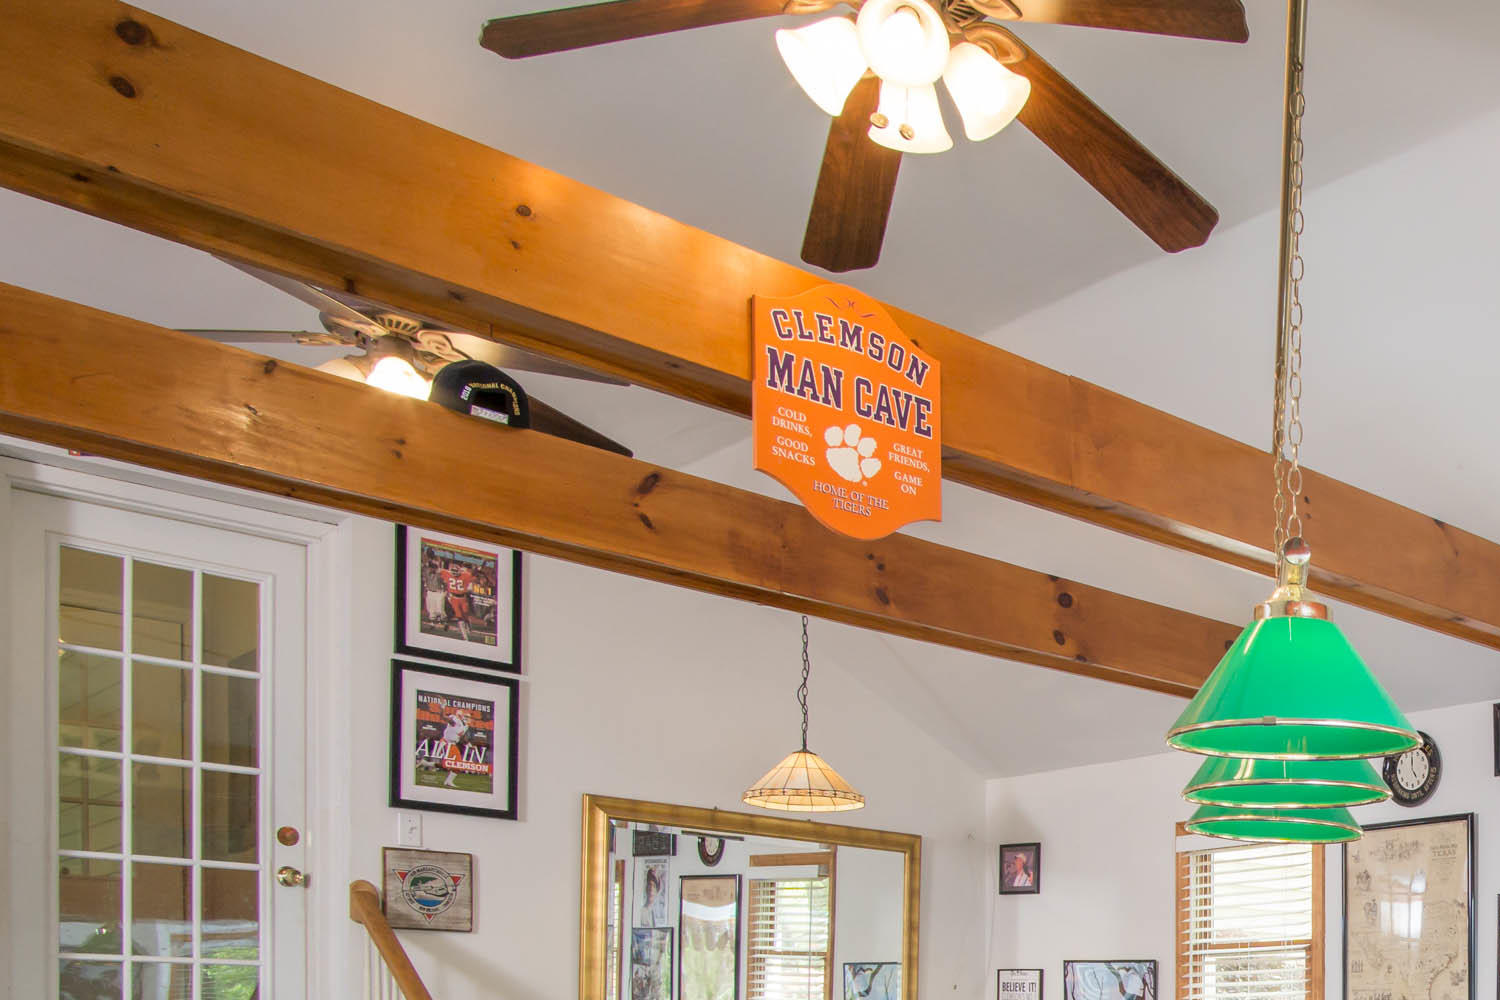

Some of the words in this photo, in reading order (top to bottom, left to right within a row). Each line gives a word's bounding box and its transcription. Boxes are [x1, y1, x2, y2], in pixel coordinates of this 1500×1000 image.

[771, 308, 929, 389] CLEMSON
[766, 345, 844, 411] MAN
[854, 376, 933, 440] CAVE
[777, 406, 807, 423] COLD
[776, 435, 809, 453] GOOD
[893, 443, 923, 460] GREAT
[771, 445, 816, 467] SNACKS
[893, 471, 923, 487] GAME
[813, 480, 847, 500] HOME
[850, 489, 865, 504] OF
[867, 494, 889, 510] THE
[900, 483, 917, 496] ON
[832, 496, 872, 517] TIGERS
[449, 578, 465, 591] 22
[444, 760, 489, 772] CLEMSON
[1002, 982, 1026, 992] BELIEVE
